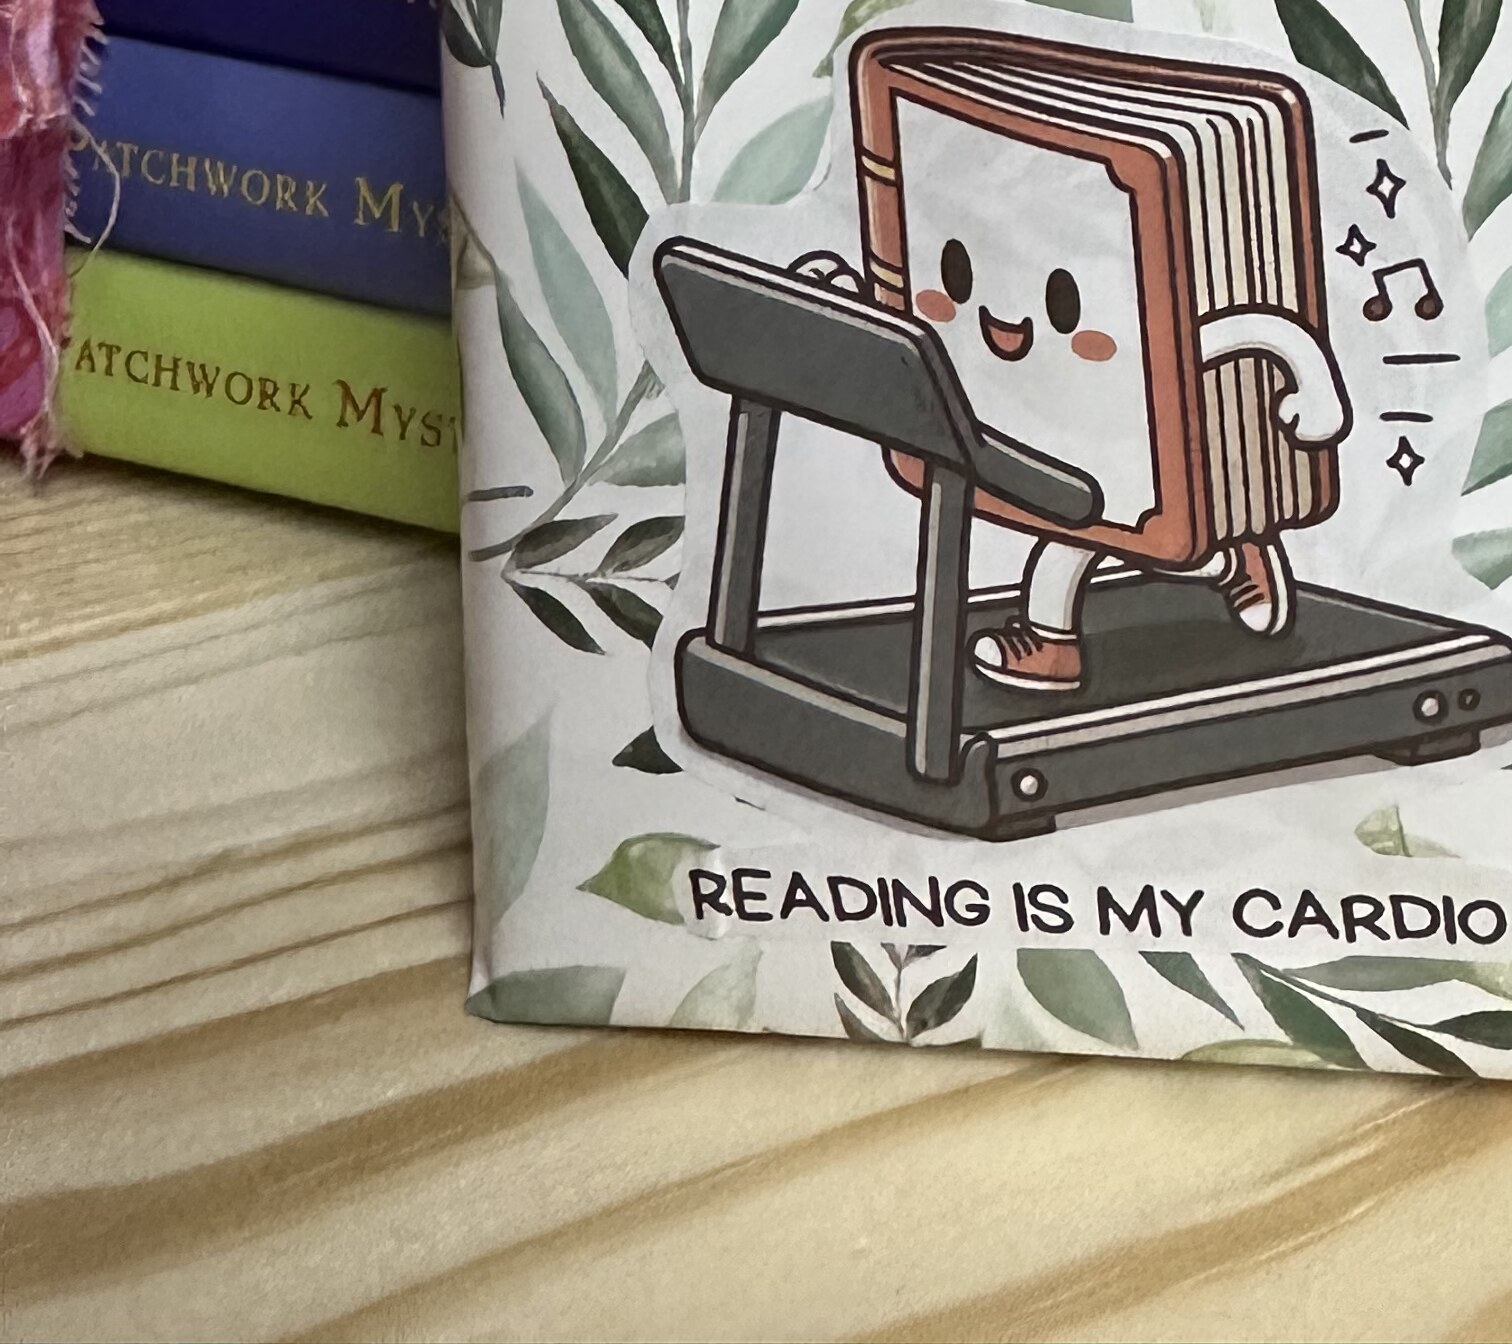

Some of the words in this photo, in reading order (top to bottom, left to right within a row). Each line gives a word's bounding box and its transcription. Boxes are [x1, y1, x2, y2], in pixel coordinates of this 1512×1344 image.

[70, 127, 330, 217] ATCHWORK
[74, 335, 314, 421] ATCHWORK
[687, 866, 991, 929] READING
[1012, 882, 1075, 936] IS
[1098, 883, 1206, 938] MY
[1231, 887, 1509, 948] CARDIO
